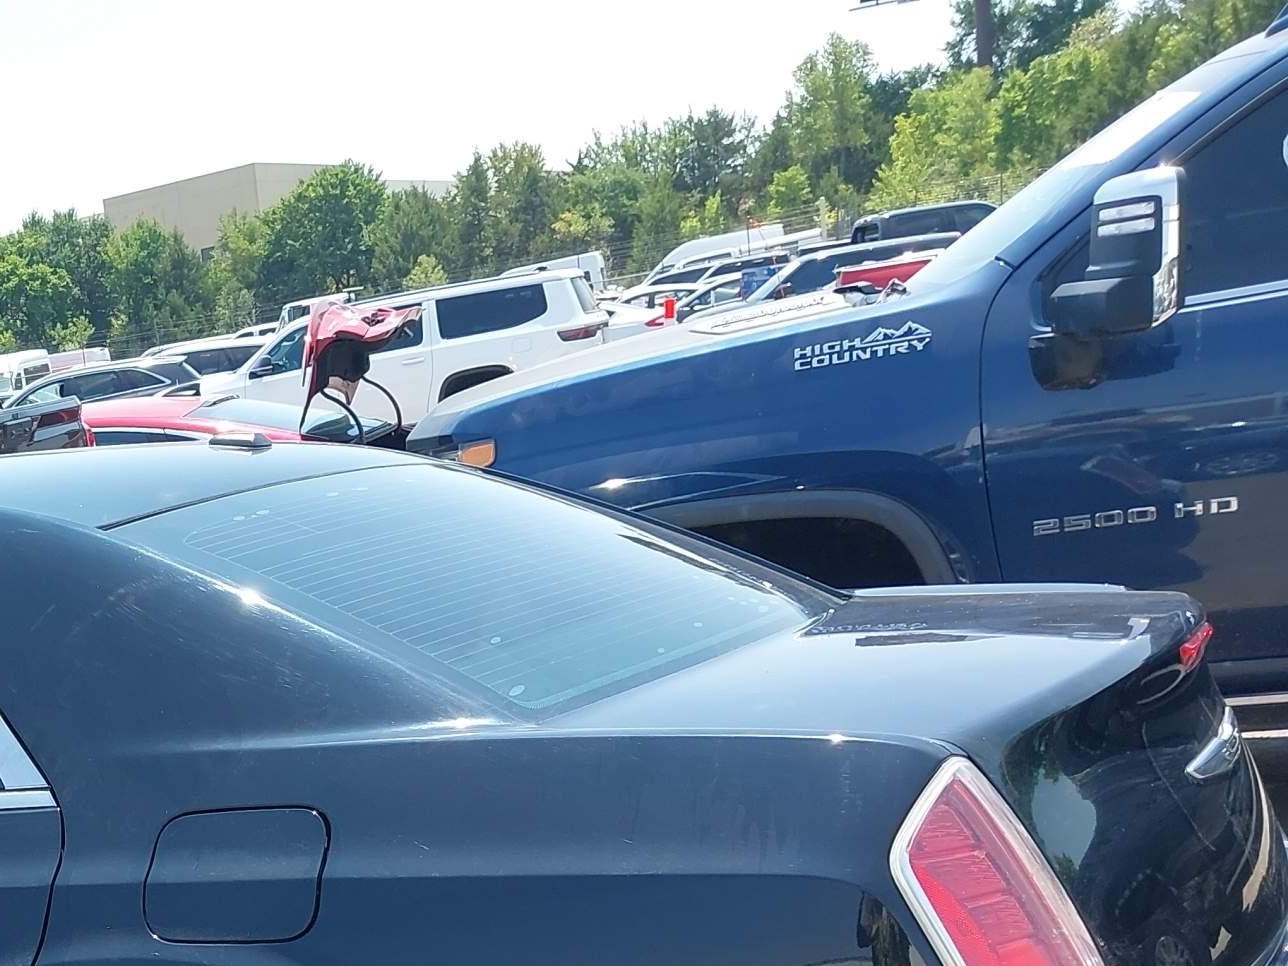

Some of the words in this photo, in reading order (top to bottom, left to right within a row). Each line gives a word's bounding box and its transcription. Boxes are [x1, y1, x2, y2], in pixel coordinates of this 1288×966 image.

[794, 337, 861, 359] HIGH
[794, 337, 930, 371] COUNTRY
[1033, 506, 1157, 536] 2500
[1174, 496, 1239, 519] HD
